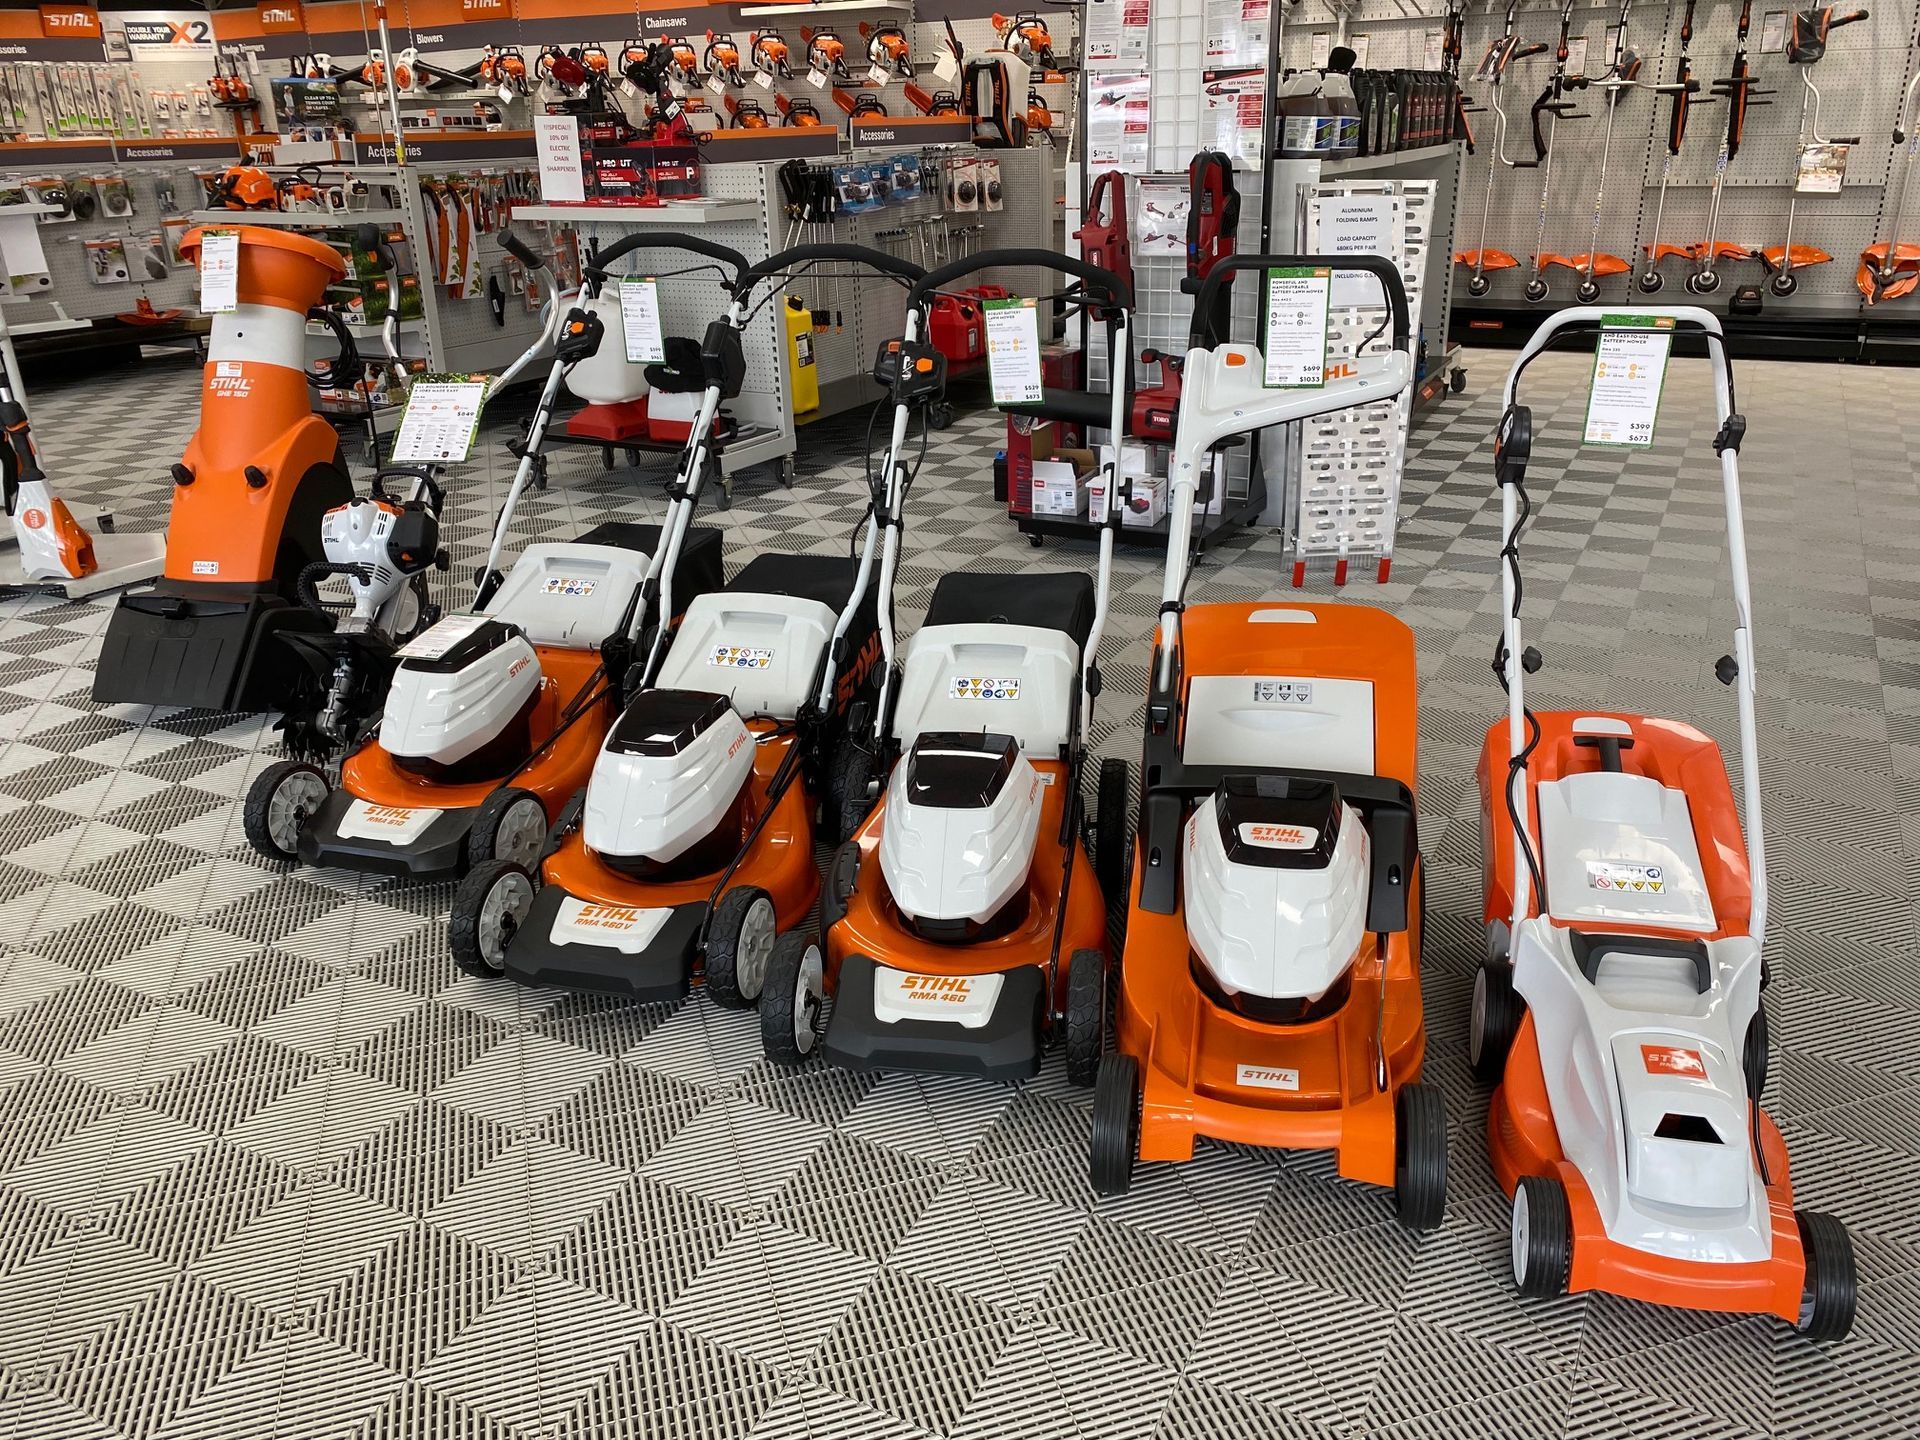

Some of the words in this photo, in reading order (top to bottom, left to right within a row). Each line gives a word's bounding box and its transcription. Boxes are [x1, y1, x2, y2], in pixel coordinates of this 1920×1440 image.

[262, 9, 295, 23] STIHL
[645, 16, 687, 28] Chainsaws
[126, 26, 152, 34] DOUBLE
[165, 21, 212, 44] X2
[416, 33, 444, 44] Blowers
[860, 128, 895, 140] Accessories
[126, 146, 174, 158] Accessories
[368, 144, 422, 158] Accesries
[602, 159, 632, 167] PROUT
[210, 378, 252, 390] STIHL
[510, 656, 531, 678] STIHL
[727, 732, 747, 759] STIHL
[363, 806, 412, 820] STIHL
[1250, 827, 1305, 838] STIHL
[578, 905, 638, 922] STIHL
[574, 918, 599, 926] RMA
[602, 921, 624, 929] 460
[900, 976, 971, 992] STIHL
[909, 992, 937, 1000] RMA
[940, 994, 966, 1002] 460
[1242, 1070, 1292, 1082] STIHL
